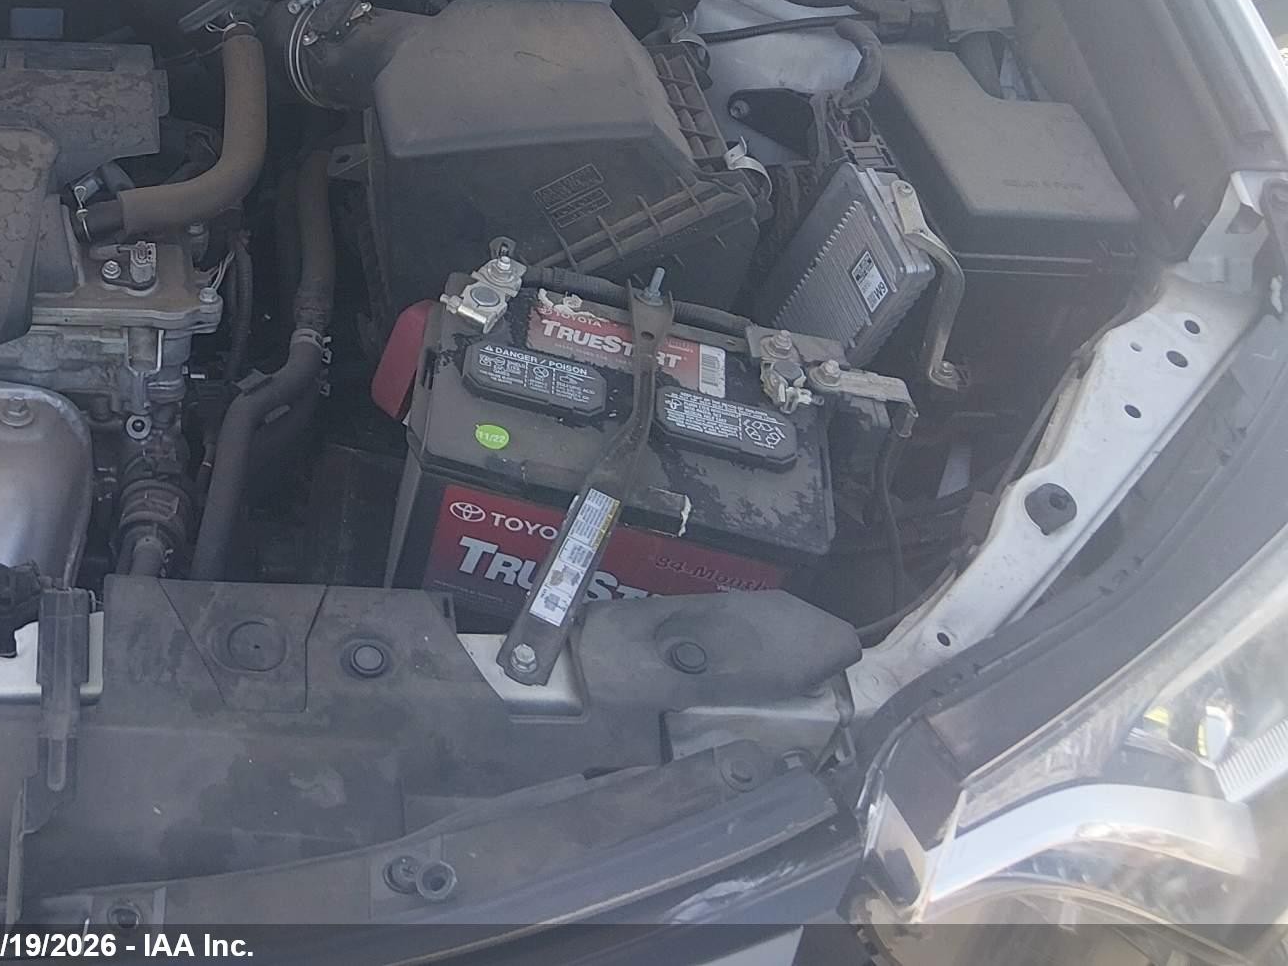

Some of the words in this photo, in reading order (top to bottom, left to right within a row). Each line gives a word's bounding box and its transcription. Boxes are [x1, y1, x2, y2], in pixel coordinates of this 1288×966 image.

[873, 281, 887, 300] W9
[495, 347, 538, 365] DANGER
[548, 360, 588, 376] POISON
